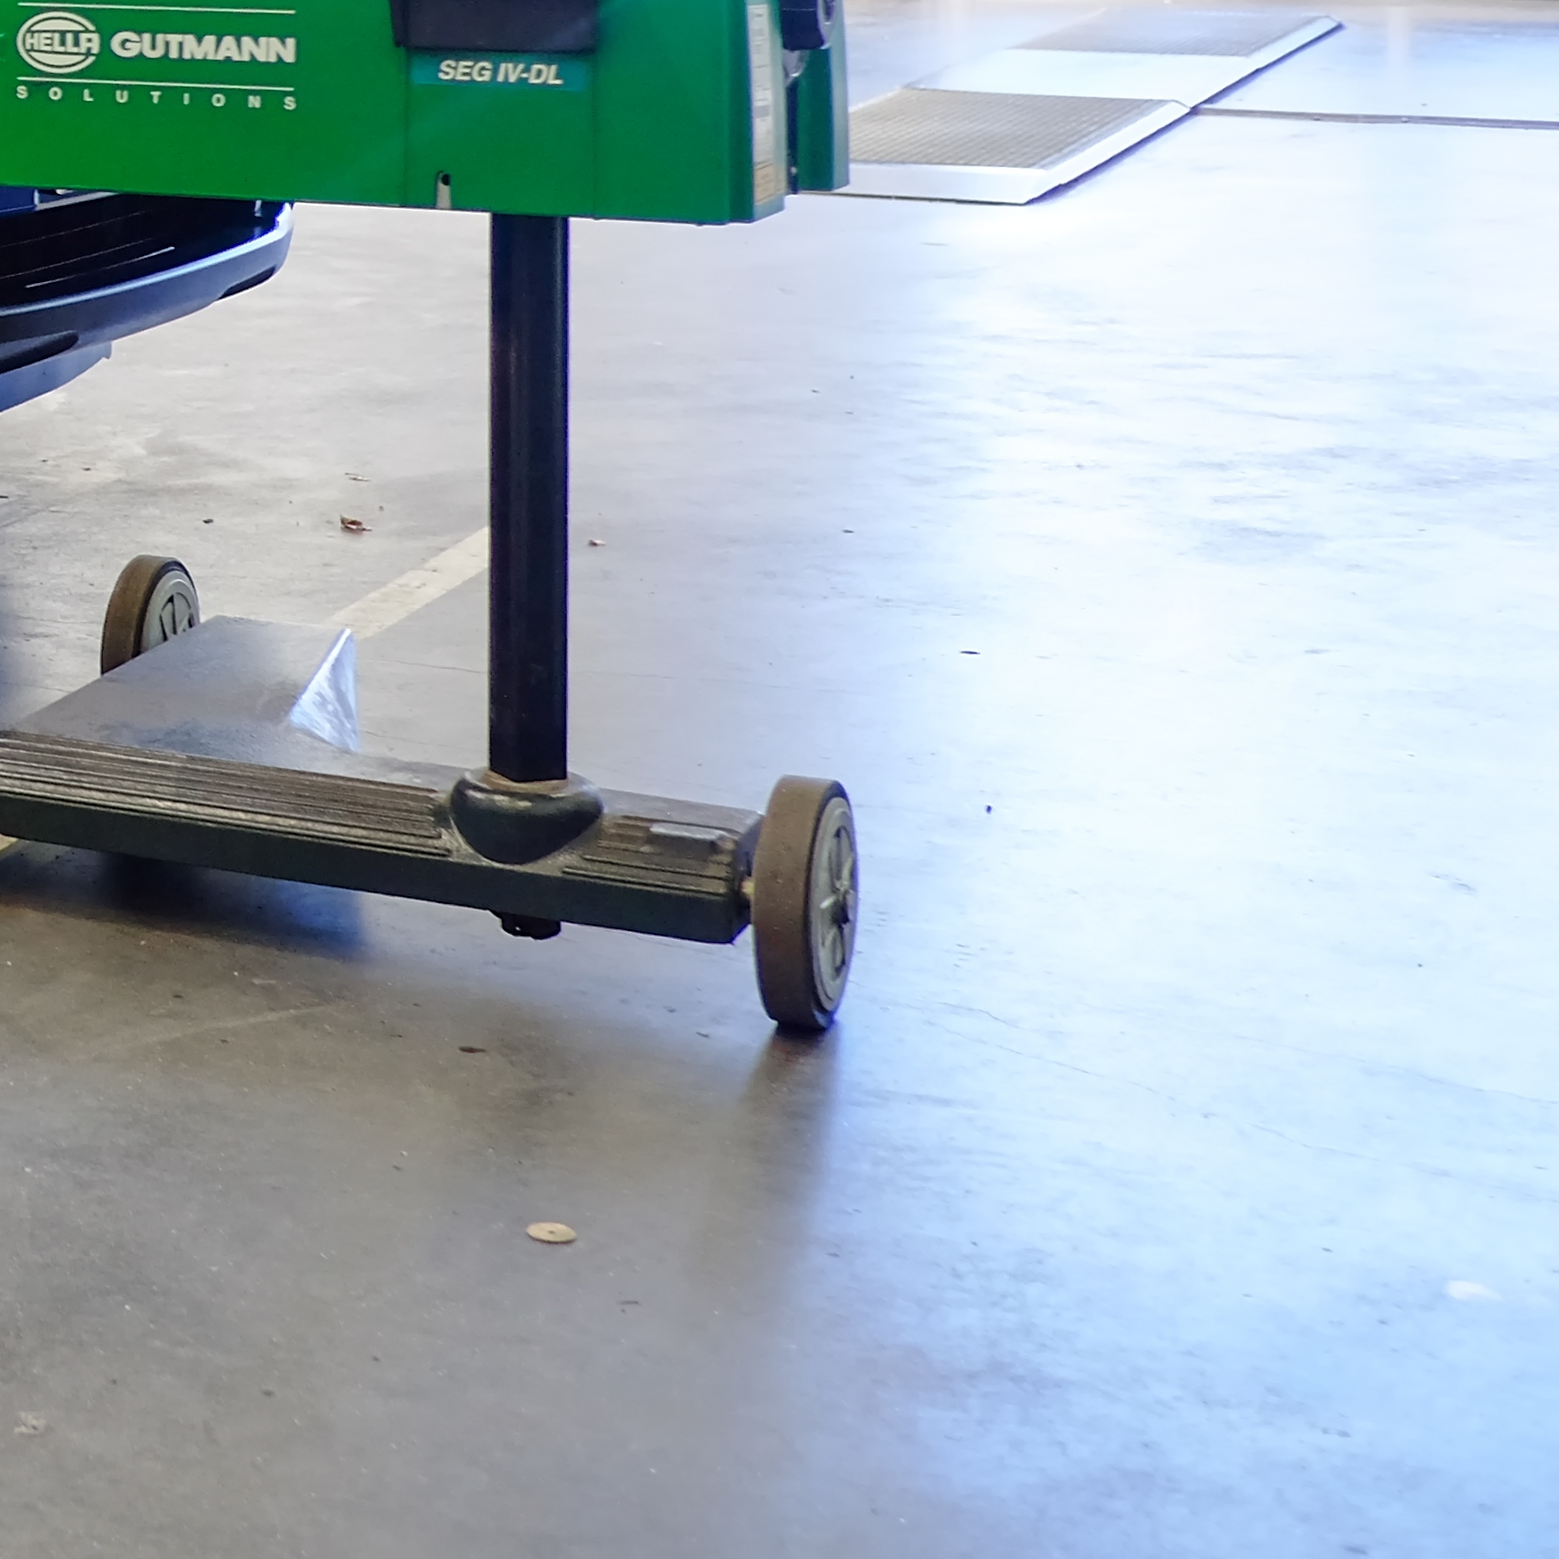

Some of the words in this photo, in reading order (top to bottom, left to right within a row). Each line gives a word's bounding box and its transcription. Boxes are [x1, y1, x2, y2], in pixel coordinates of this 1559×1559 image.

[25, 31, 101, 55] HELLA
[110, 31, 297, 64] GUTMANN
[438, 59, 493, 82] SEG
[496, 62, 565, 85] IV-DL
[16, 85, 297, 111] SOLUTIONS
